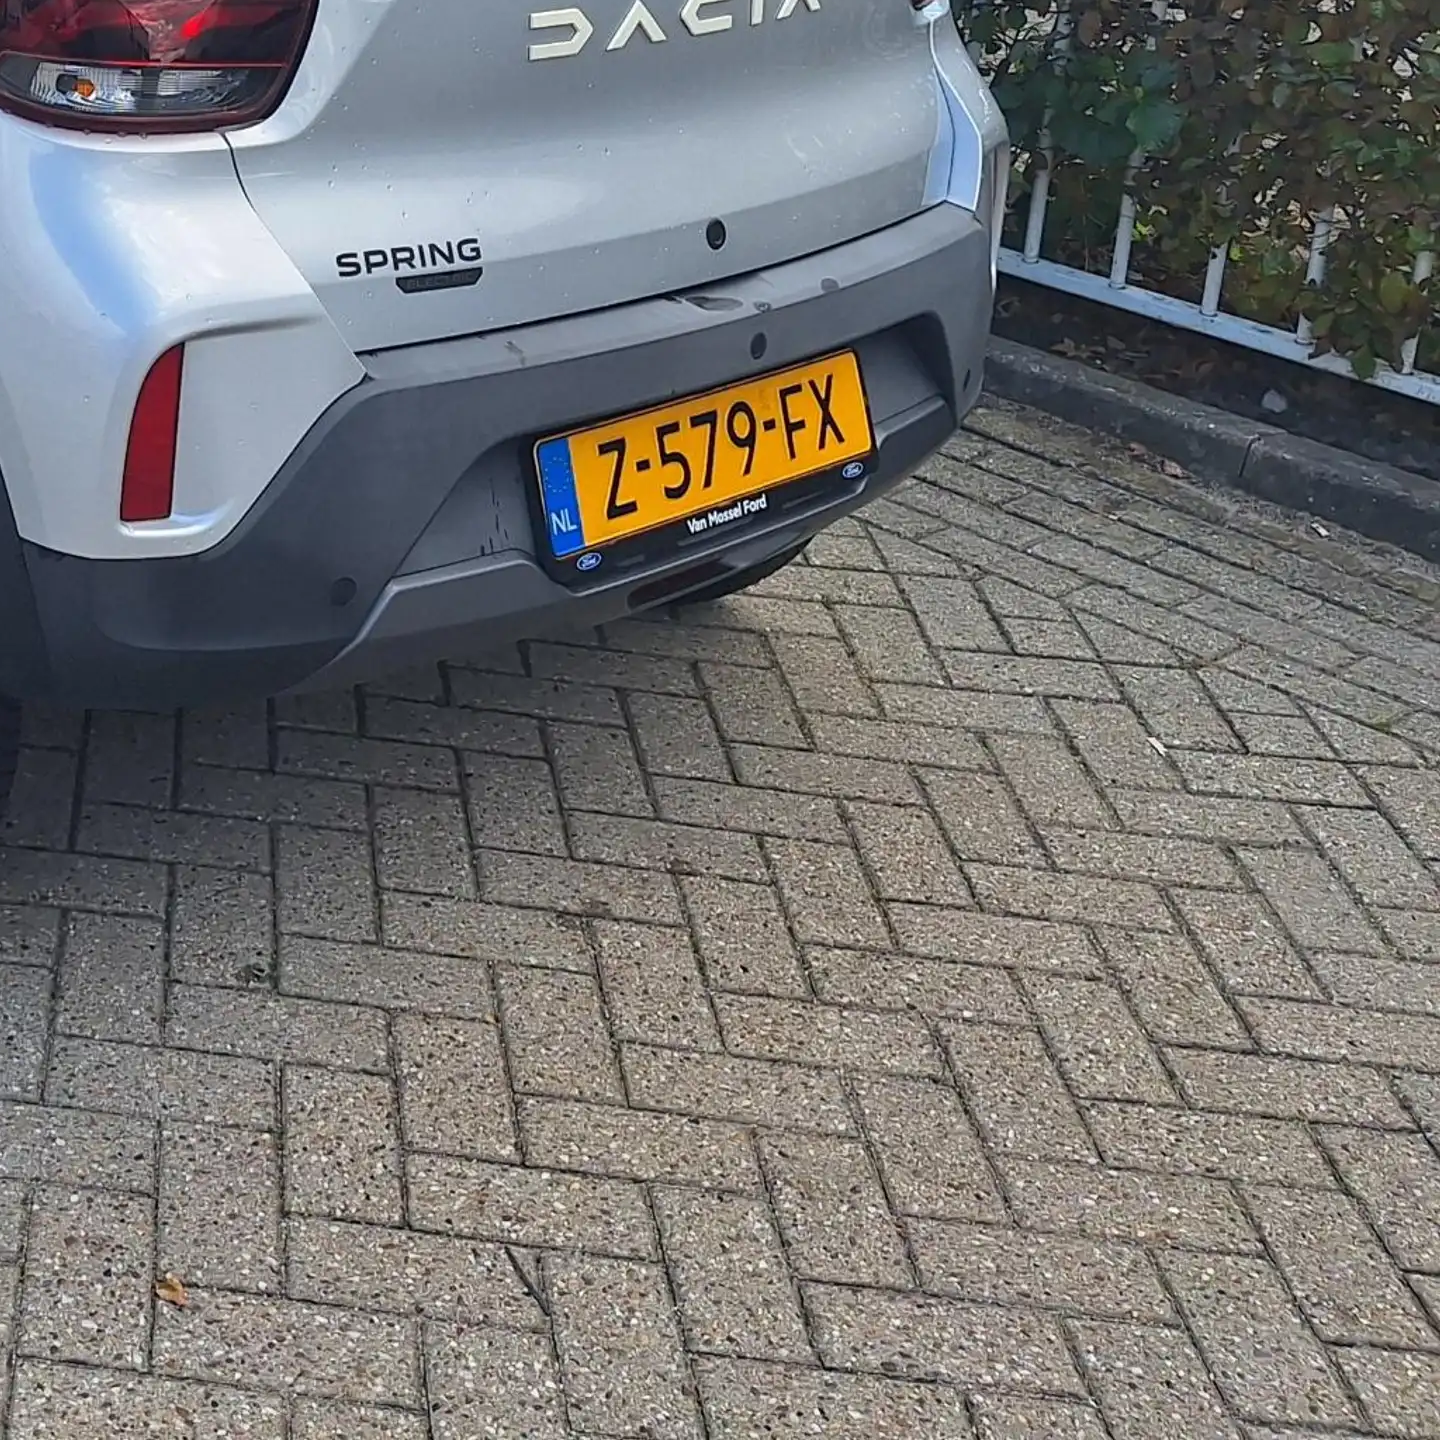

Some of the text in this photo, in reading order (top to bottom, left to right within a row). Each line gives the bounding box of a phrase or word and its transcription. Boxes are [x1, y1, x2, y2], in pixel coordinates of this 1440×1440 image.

[336, 238, 482, 277] SPRING
[597, 373, 845, 521] Z-579-FX
[551, 508, 578, 536] NL
[687, 494, 767, 534] Van Mossel Ford
